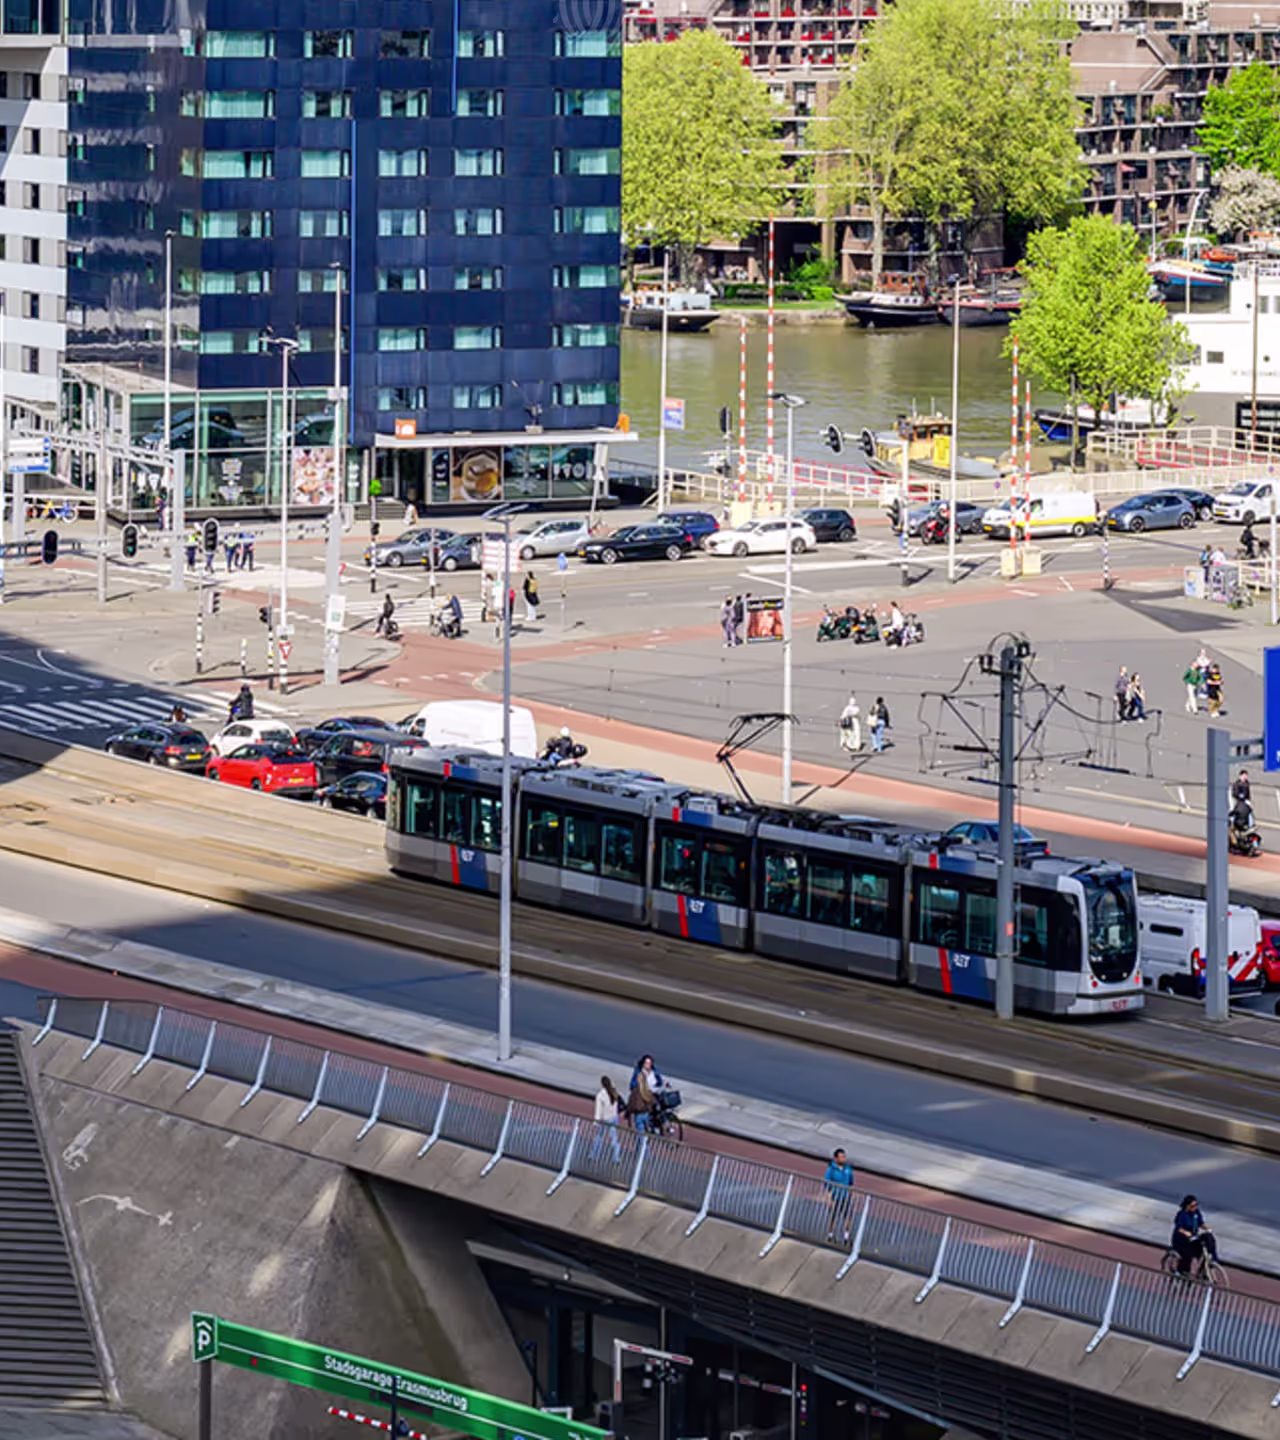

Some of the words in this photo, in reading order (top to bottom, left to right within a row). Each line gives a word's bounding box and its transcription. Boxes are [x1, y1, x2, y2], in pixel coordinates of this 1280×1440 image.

[197, 1329, 211, 1352] P
[324, 1355, 393, 1387] Stadsgarage
[395, 1375, 468, 1411] Erasmusbrug
